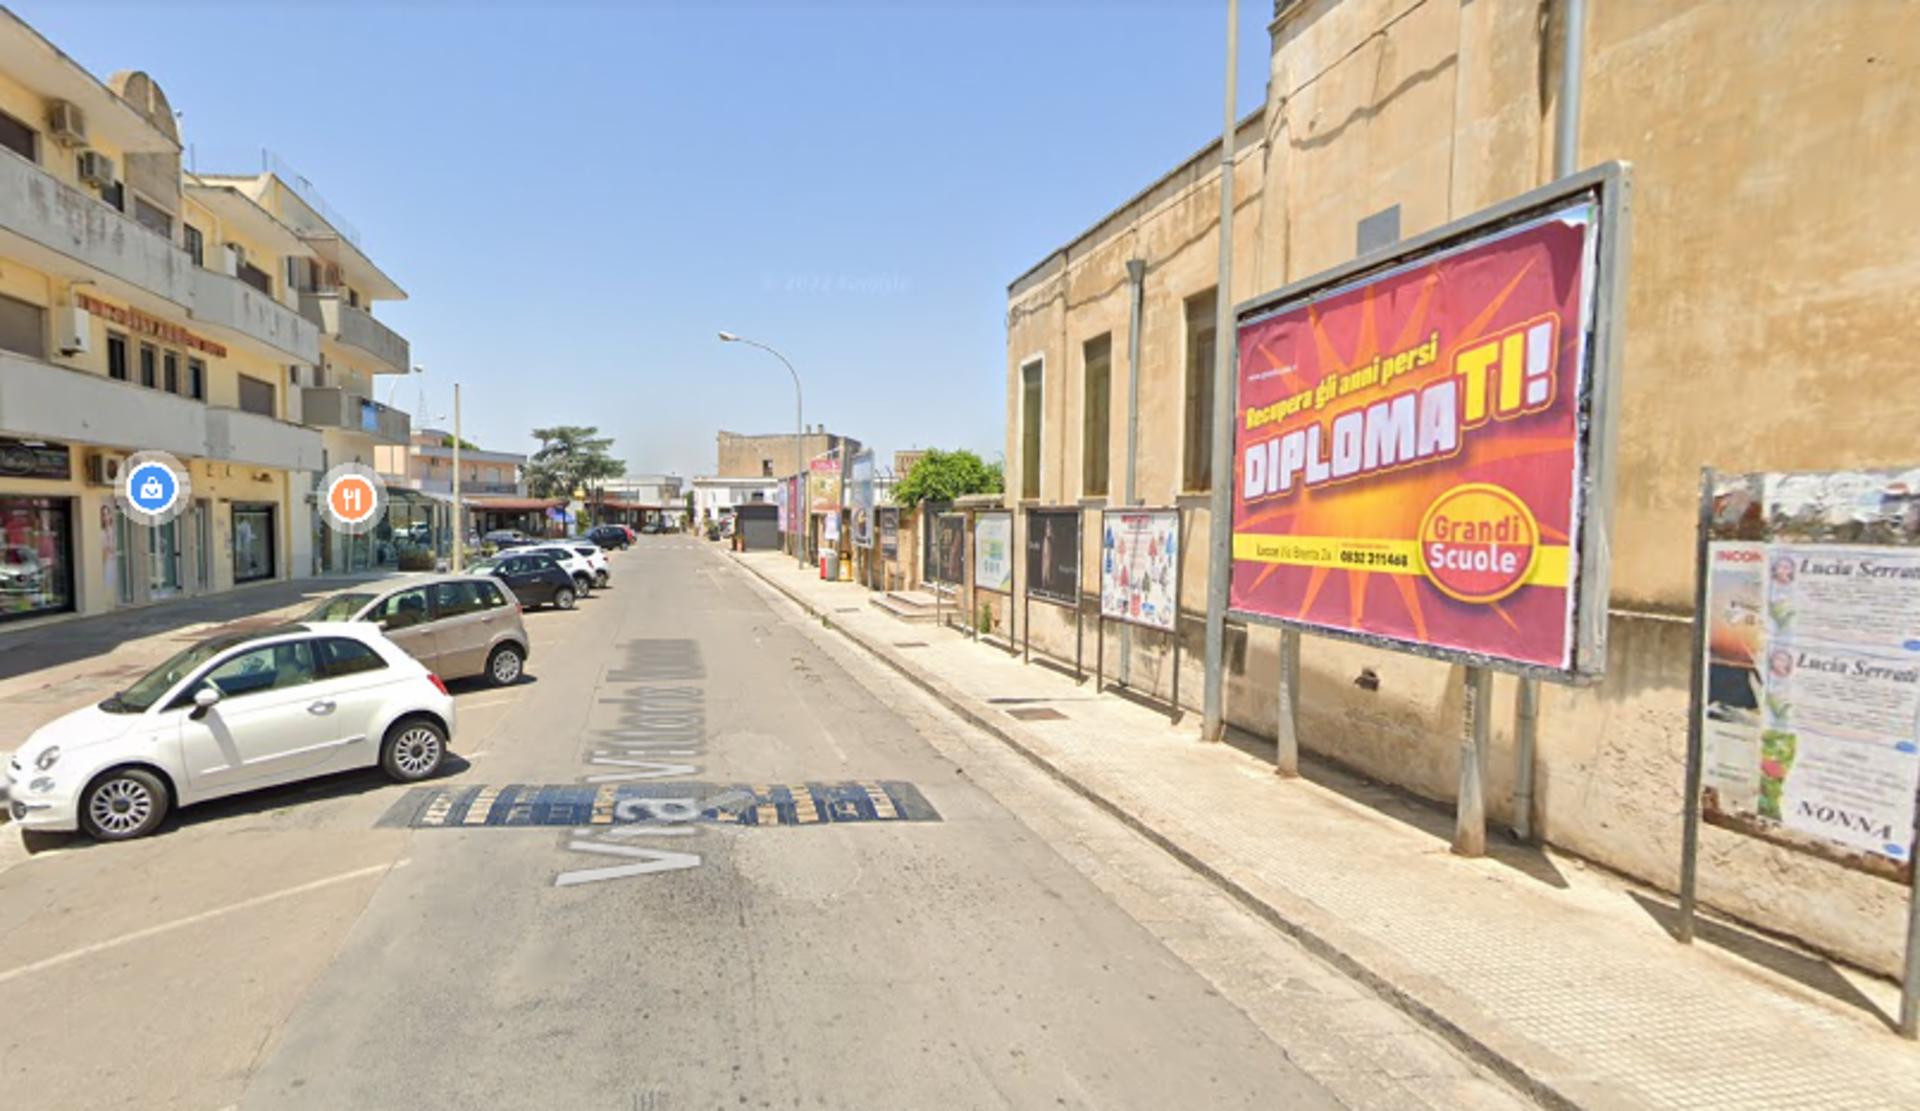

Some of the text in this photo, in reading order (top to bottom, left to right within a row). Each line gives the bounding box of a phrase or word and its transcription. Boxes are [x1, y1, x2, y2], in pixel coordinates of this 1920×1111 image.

[1246, 389, 1313, 429] Recupera
[1315, 373, 1338, 411] gli
[1339, 356, 1379, 395] anni
[1380, 332, 1439, 386] persi
[1434, 515, 1519, 542] Grandi
[1429, 543, 1516, 573] Scuole
[1800, 559, 1852, 576] Lucia
[1796, 652, 1848, 675] Lucia
[1797, 800, 1893, 840] NONNA
